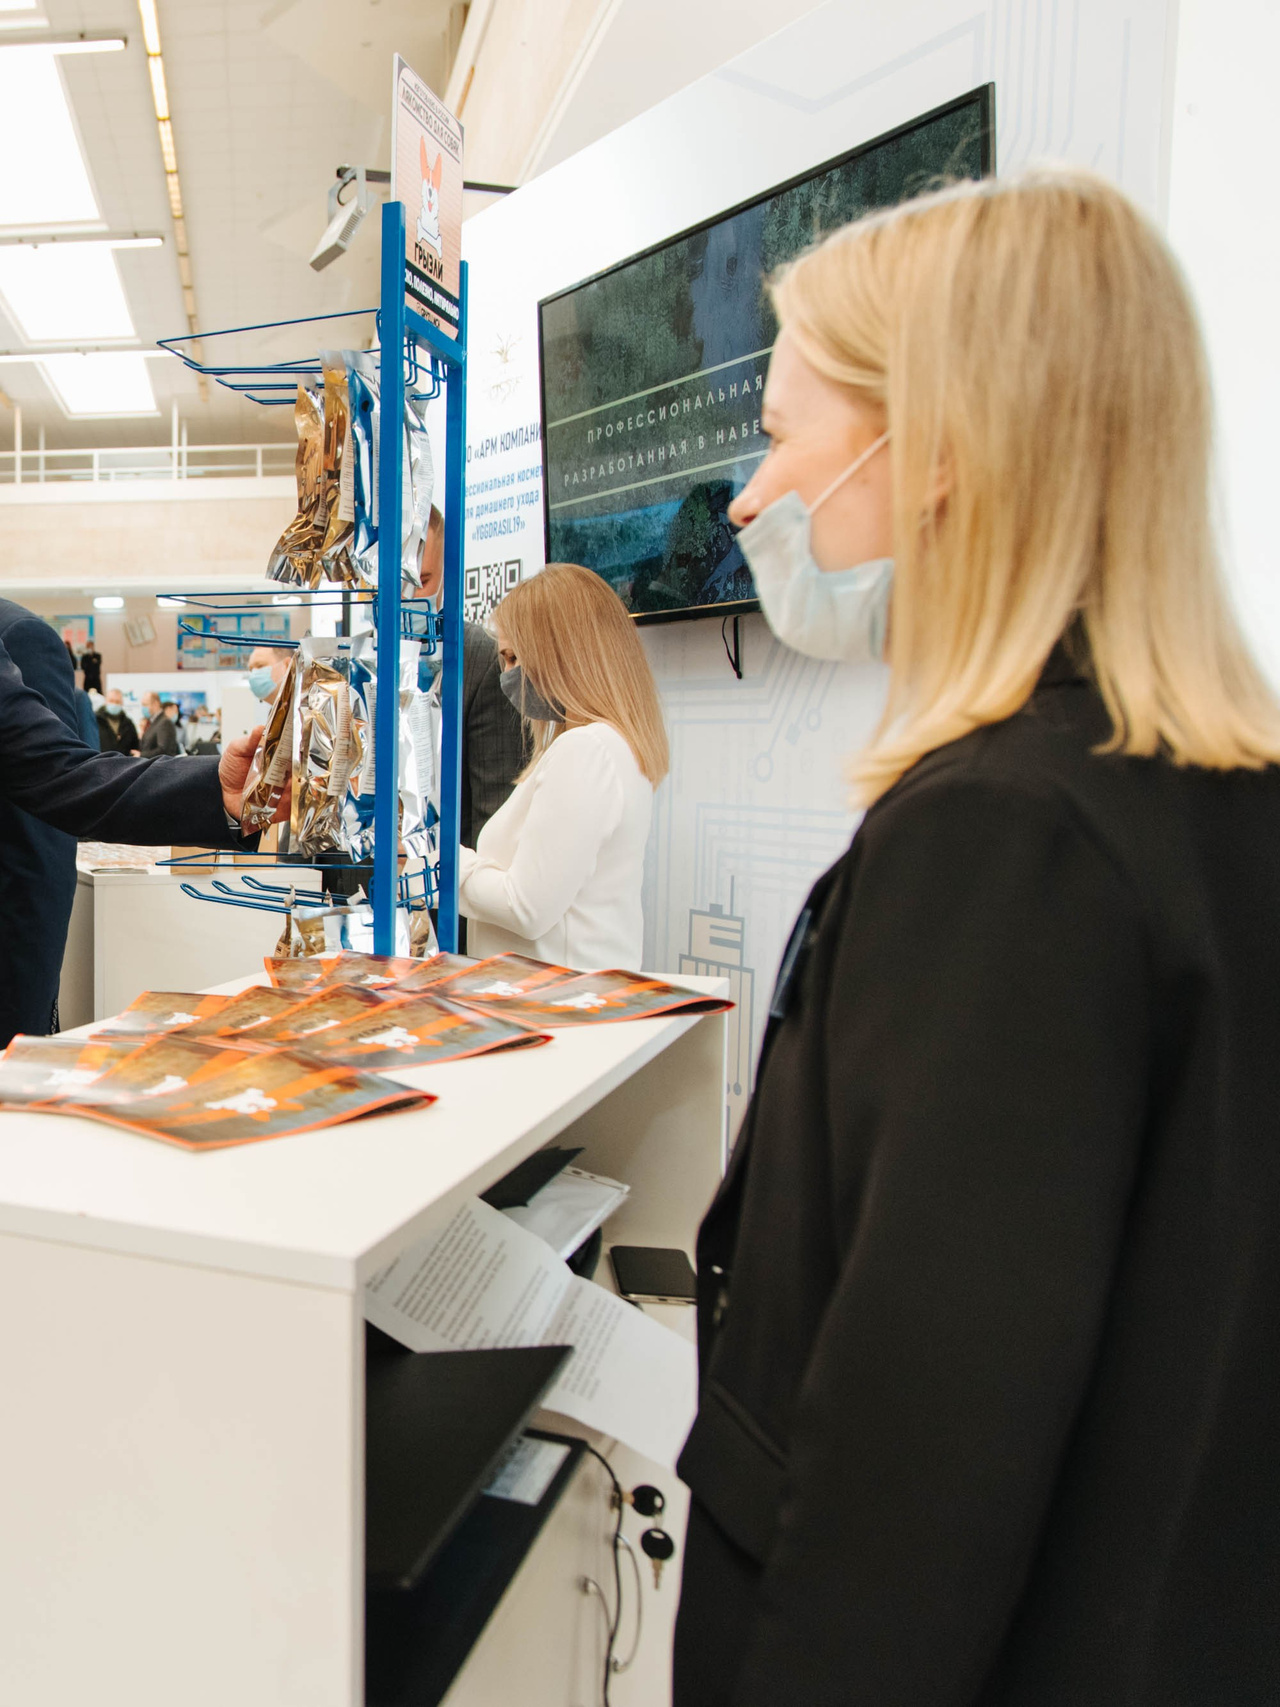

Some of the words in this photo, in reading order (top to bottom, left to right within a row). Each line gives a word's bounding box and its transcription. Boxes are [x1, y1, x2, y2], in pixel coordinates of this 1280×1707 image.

[402, 86, 433, 129] ЛАКОМСТВО
[433, 120, 444, 140] ДЛЯ
[414, 241, 443, 282] ГРЫЗЛИ
[587, 374, 763, 443] ПРОФЕССИОНАЛЬНАЯ
[465, 444, 472, 464] О
[564, 439, 688, 487] РАЗРАБОТАННАЯ
[698, 435, 705, 450] В
[475, 498, 515, 520] домашнего
[516, 489, 540, 511] ухода
